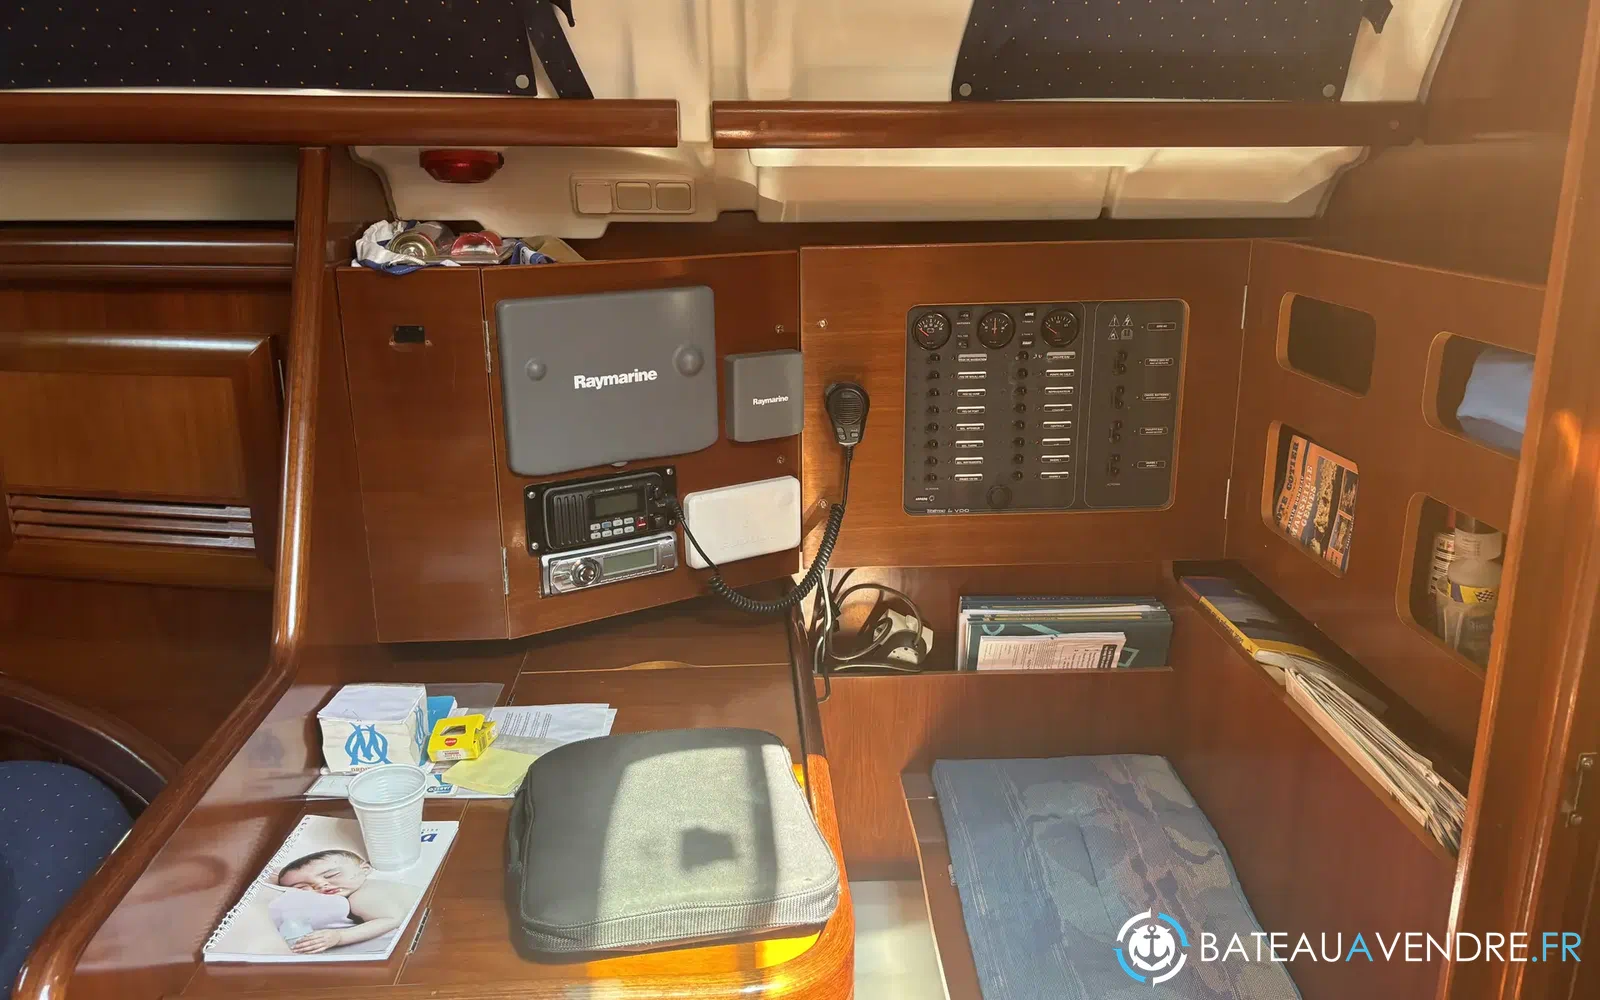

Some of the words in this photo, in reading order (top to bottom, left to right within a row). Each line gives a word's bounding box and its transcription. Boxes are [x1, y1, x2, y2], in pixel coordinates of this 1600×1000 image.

[573, 368, 658, 390] Raymarine
[752, 395, 789, 406] Raymarine
[1276, 496, 1288, 526] OTE
[1287, 442, 1299, 491] COTIER
[1292, 465, 1313, 538] MARSEILLE
